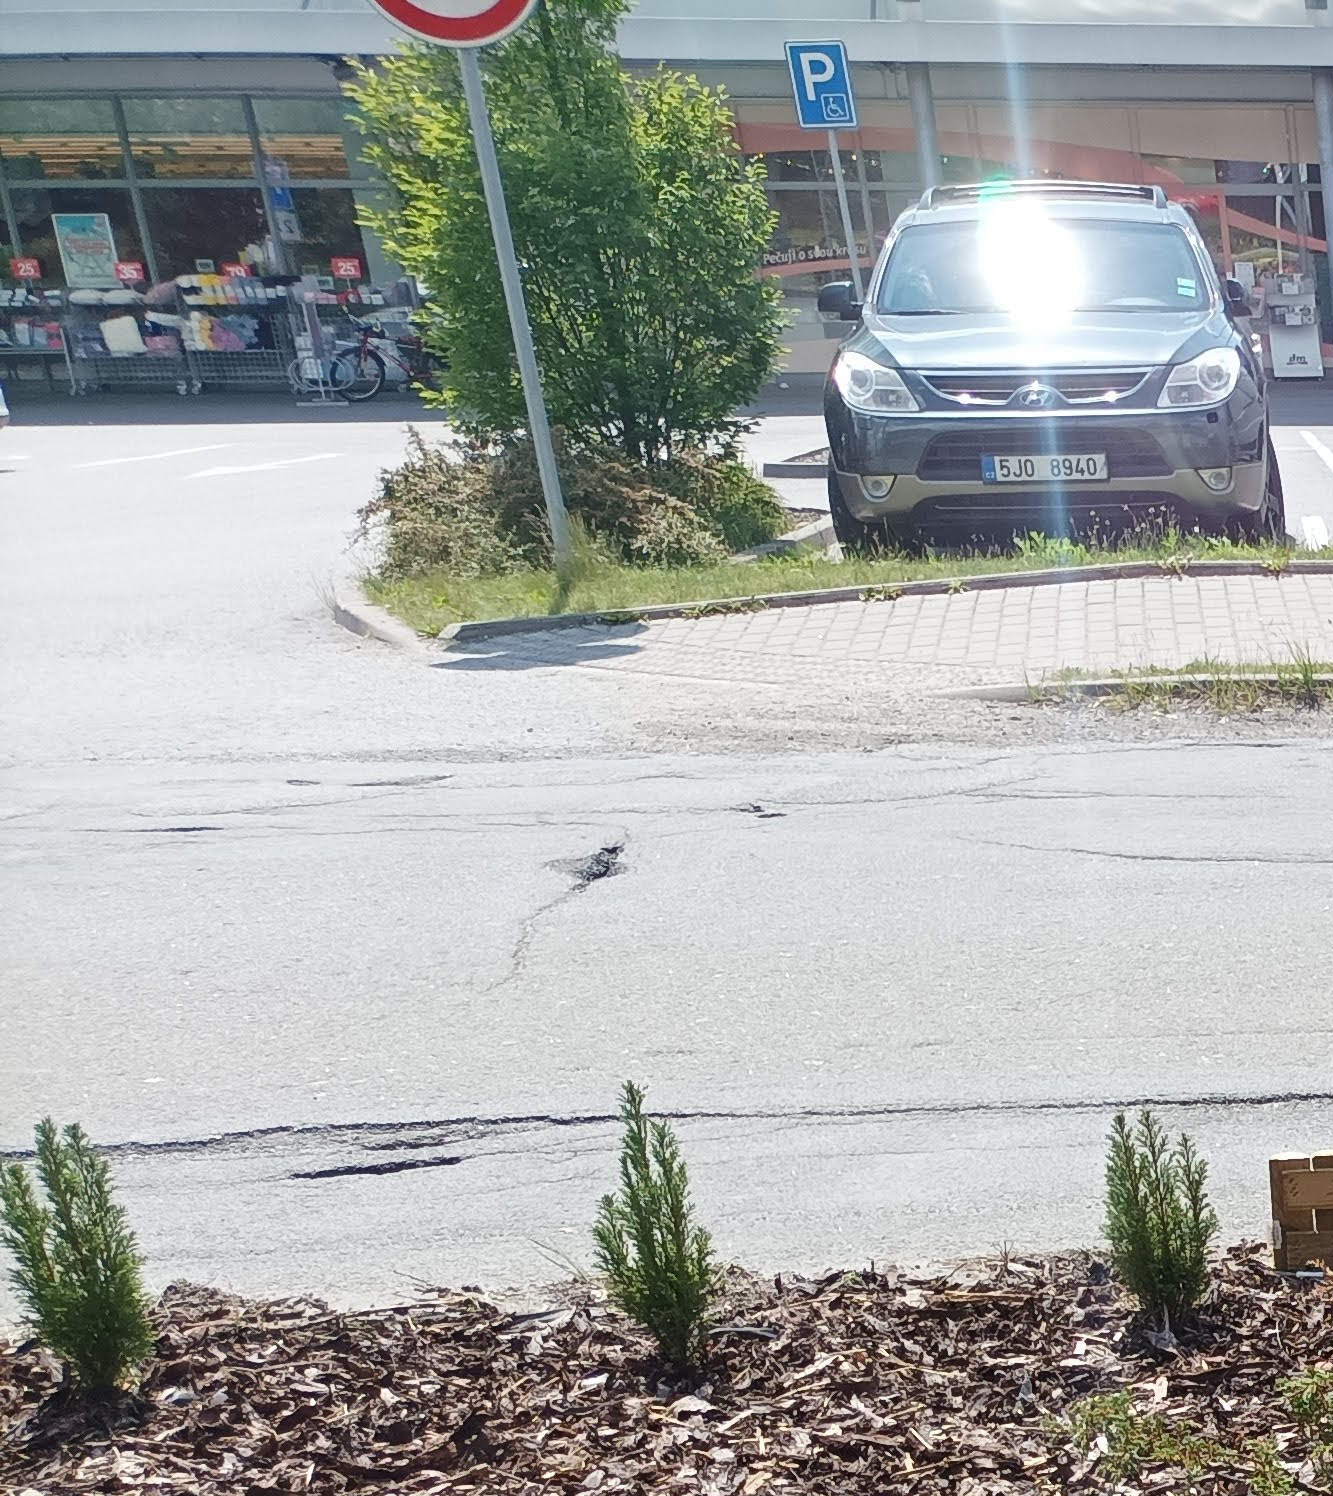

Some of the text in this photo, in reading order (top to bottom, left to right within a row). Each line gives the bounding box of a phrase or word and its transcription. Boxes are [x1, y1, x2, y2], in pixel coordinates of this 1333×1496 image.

[799, 52, 835, 101] P
[798, 250, 806, 261] o
[835, 243, 867, 257] krsu
[1289, 353, 1306, 363] dm
[1049, 457, 1098, 477] 8940
